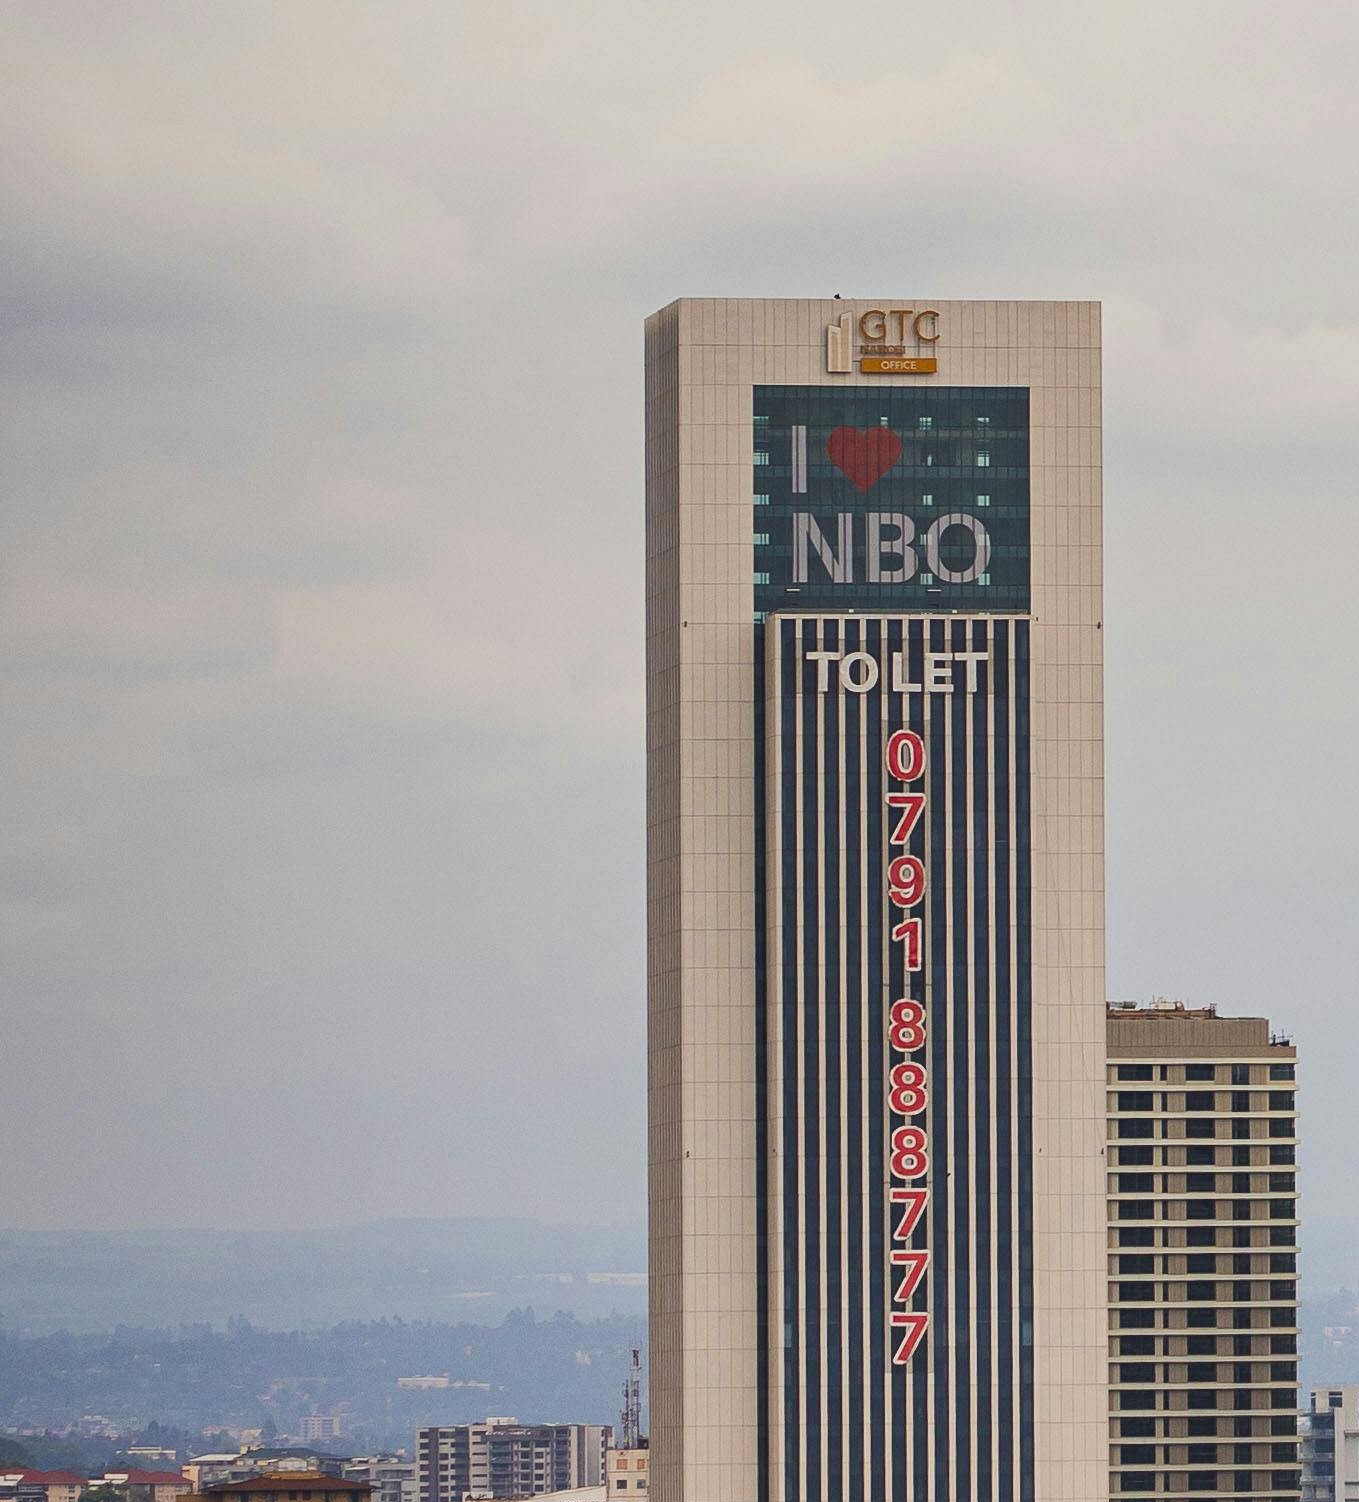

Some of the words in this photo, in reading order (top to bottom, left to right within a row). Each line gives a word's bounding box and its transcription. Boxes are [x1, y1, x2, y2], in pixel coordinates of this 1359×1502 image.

[859, 310, 940, 341] GTC
[881, 361, 917, 370] OFFICE
[792, 425, 807, 493] I
[792, 512, 991, 584] NBO
[806, 651, 879, 693] TO
[893, 651, 989, 693] LET
